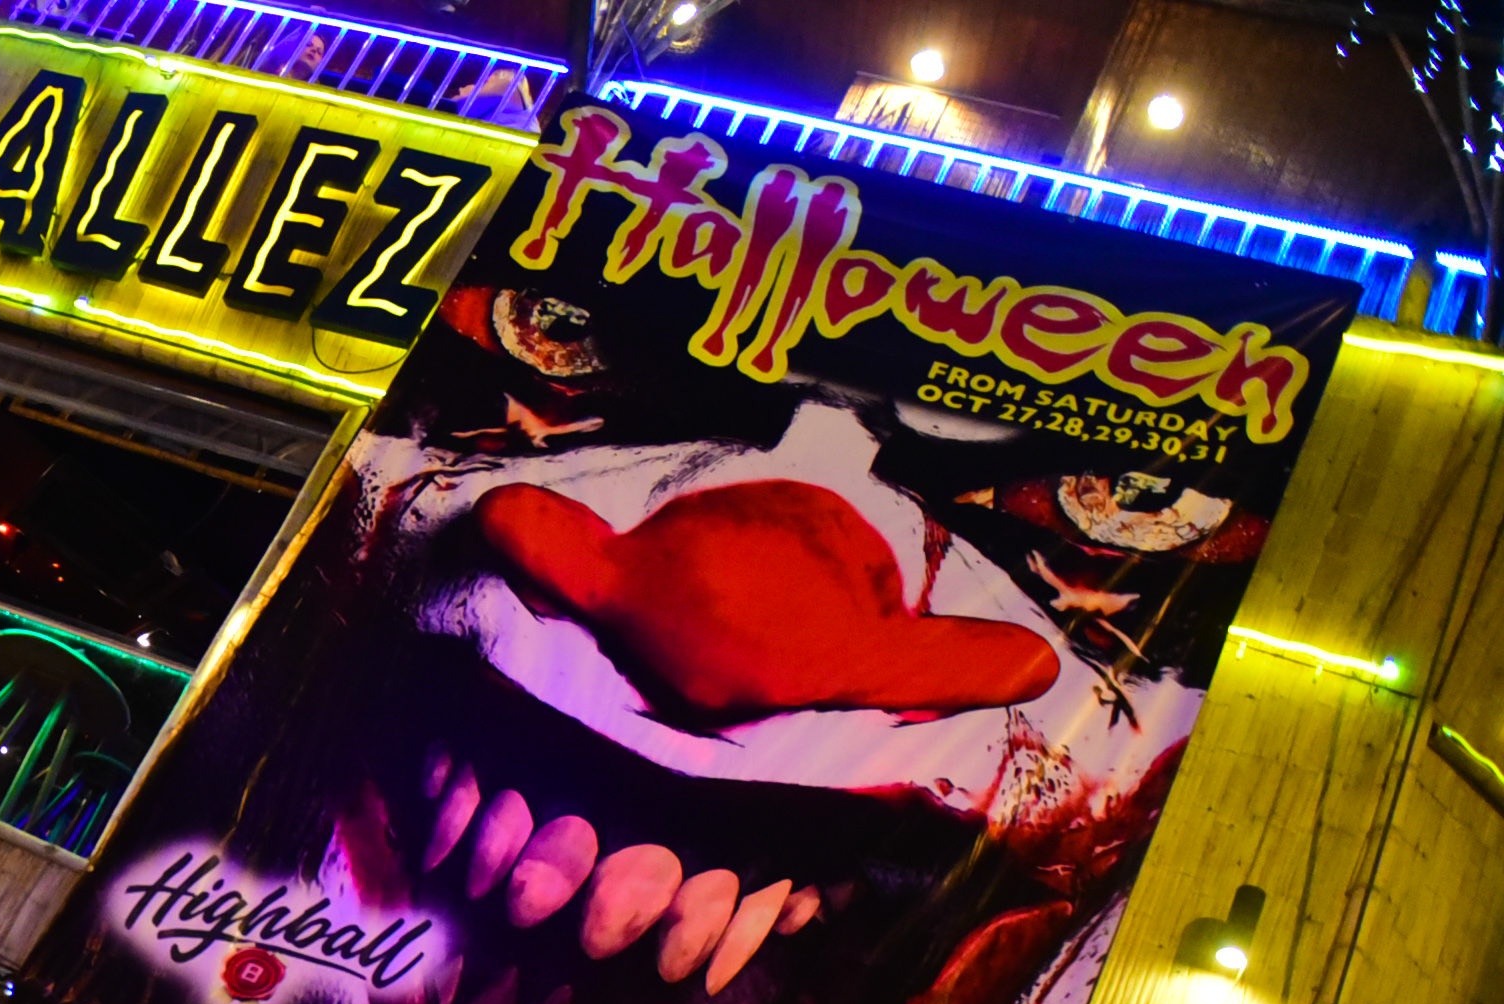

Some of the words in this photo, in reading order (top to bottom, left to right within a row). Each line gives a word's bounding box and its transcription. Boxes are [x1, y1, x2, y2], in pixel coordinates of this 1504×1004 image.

[510, 105, 1309, 445] Halloween
[916, 383, 992, 414] OCT
[997, 402, 1228, 464] 27,28,29,30,31
[927, 360, 1027, 401] FROM
[1034, 389, 1238, 442] SATURDAY
[125, 852, 433, 989] Highball
